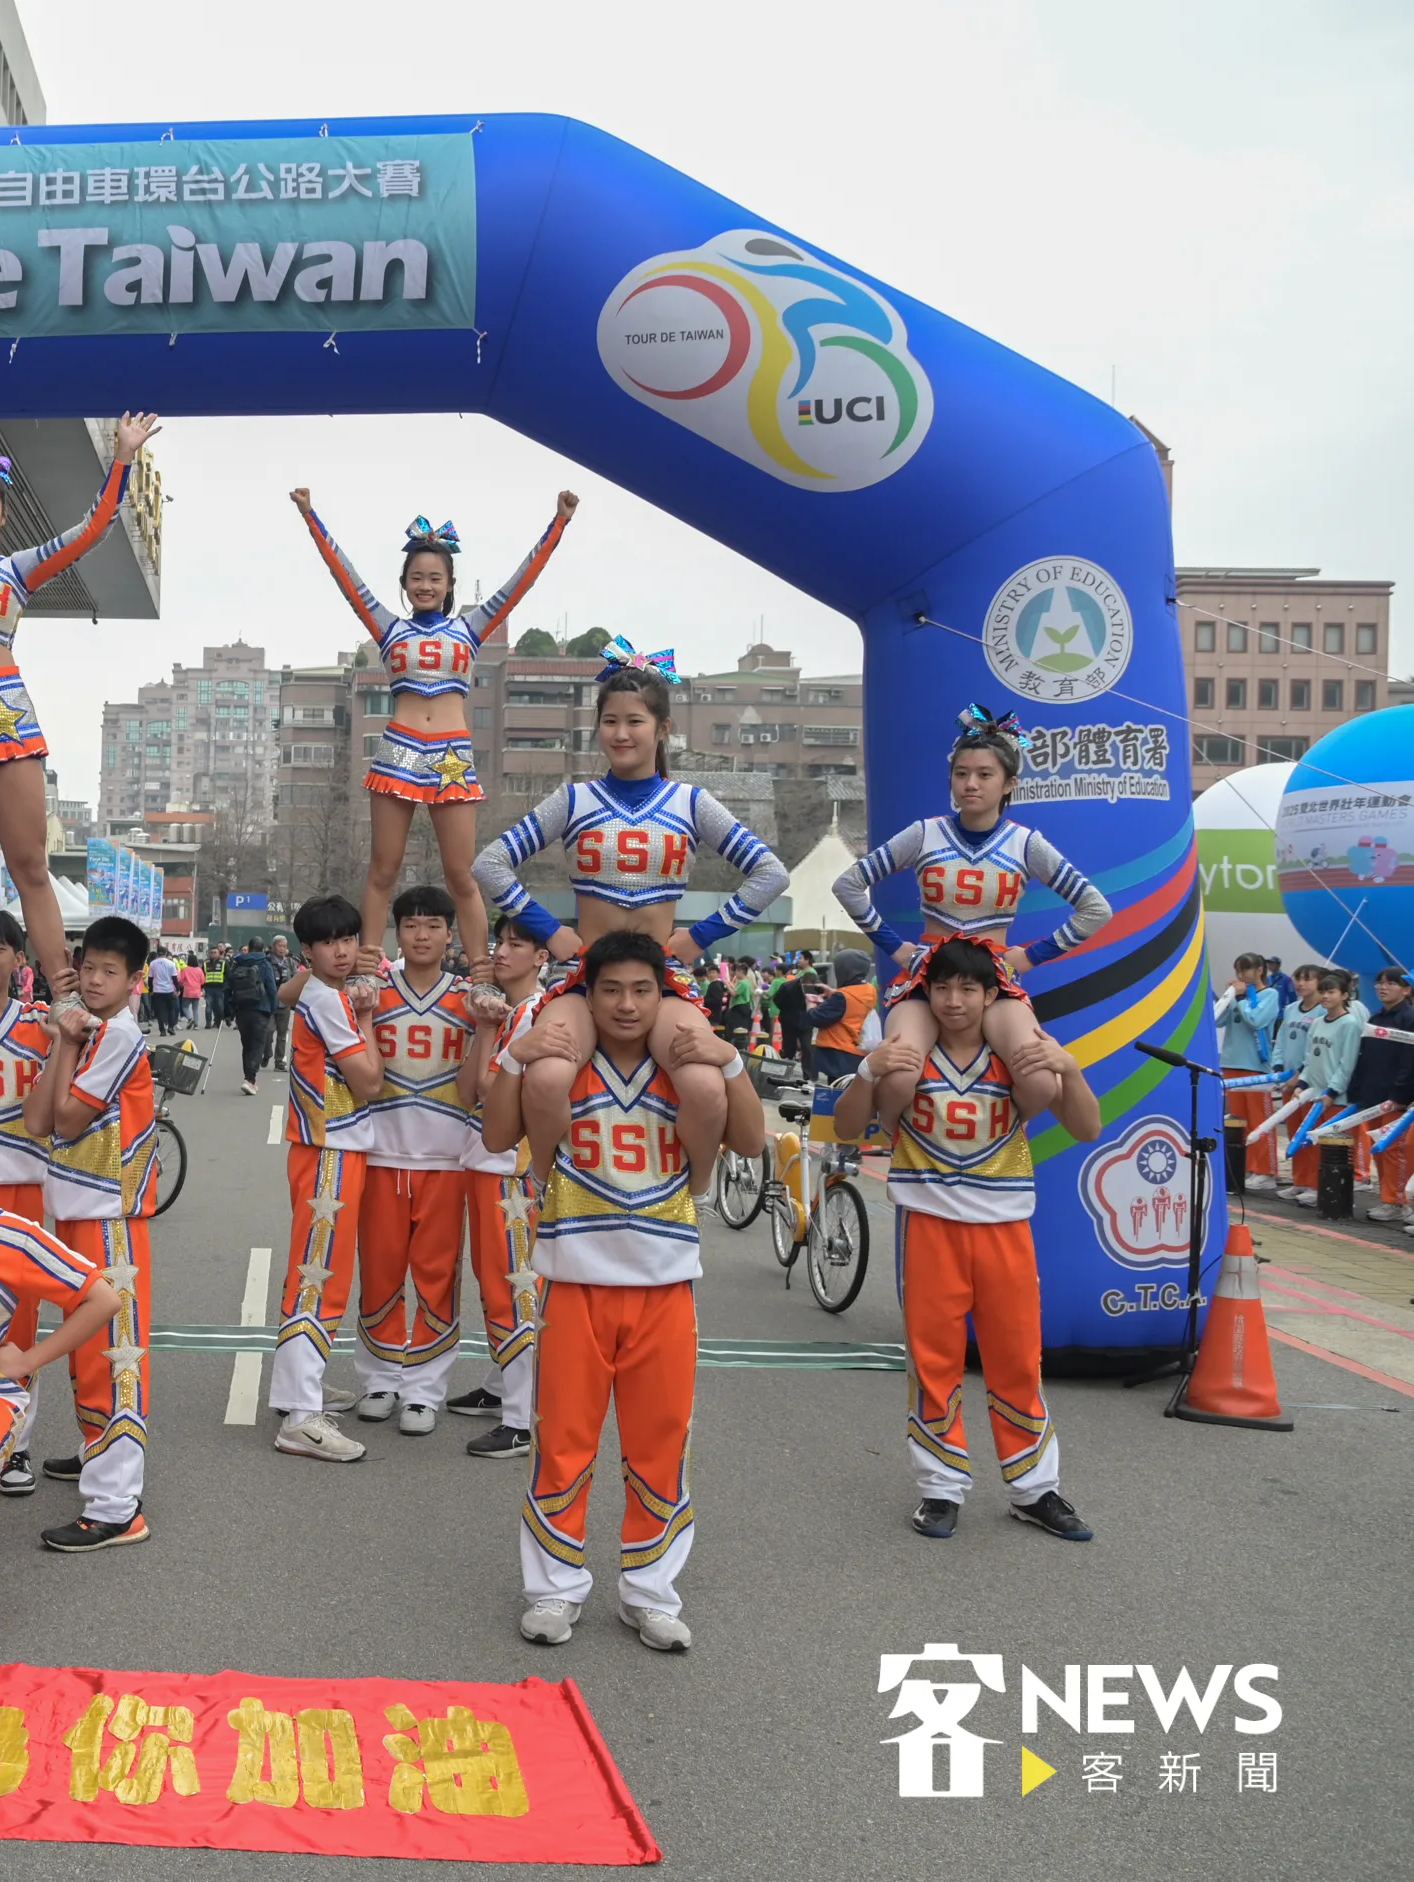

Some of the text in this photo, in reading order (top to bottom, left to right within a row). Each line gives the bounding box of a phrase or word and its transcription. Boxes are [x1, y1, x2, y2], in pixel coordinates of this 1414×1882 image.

[37, 223, 428, 307] Taiwan
[625, 328, 724, 345] TOUR DE TAIWAN
[814, 395, 886, 425] UCI
[992, 564, 1125, 673] MINISTRY OF EDUCATION
[389, 639, 471, 676] SSH
[1018, 666, 1107, 698] 教育部
[1027, 725, 1169, 771] 部體育署
[1011, 775, 1168, 800] inistration Ministry of Education
[1305, 811, 1355, 826] MASTERS
[1359, 807, 1408, 821] GAMES
[576, 829, 689, 877] SSH
[921, 865, 1023, 909] SSH
[374, 1023, 466, 1062] SSH
[912, 1093, 1010, 1141] SSH
[569, 1119, 683, 1176] SSH
